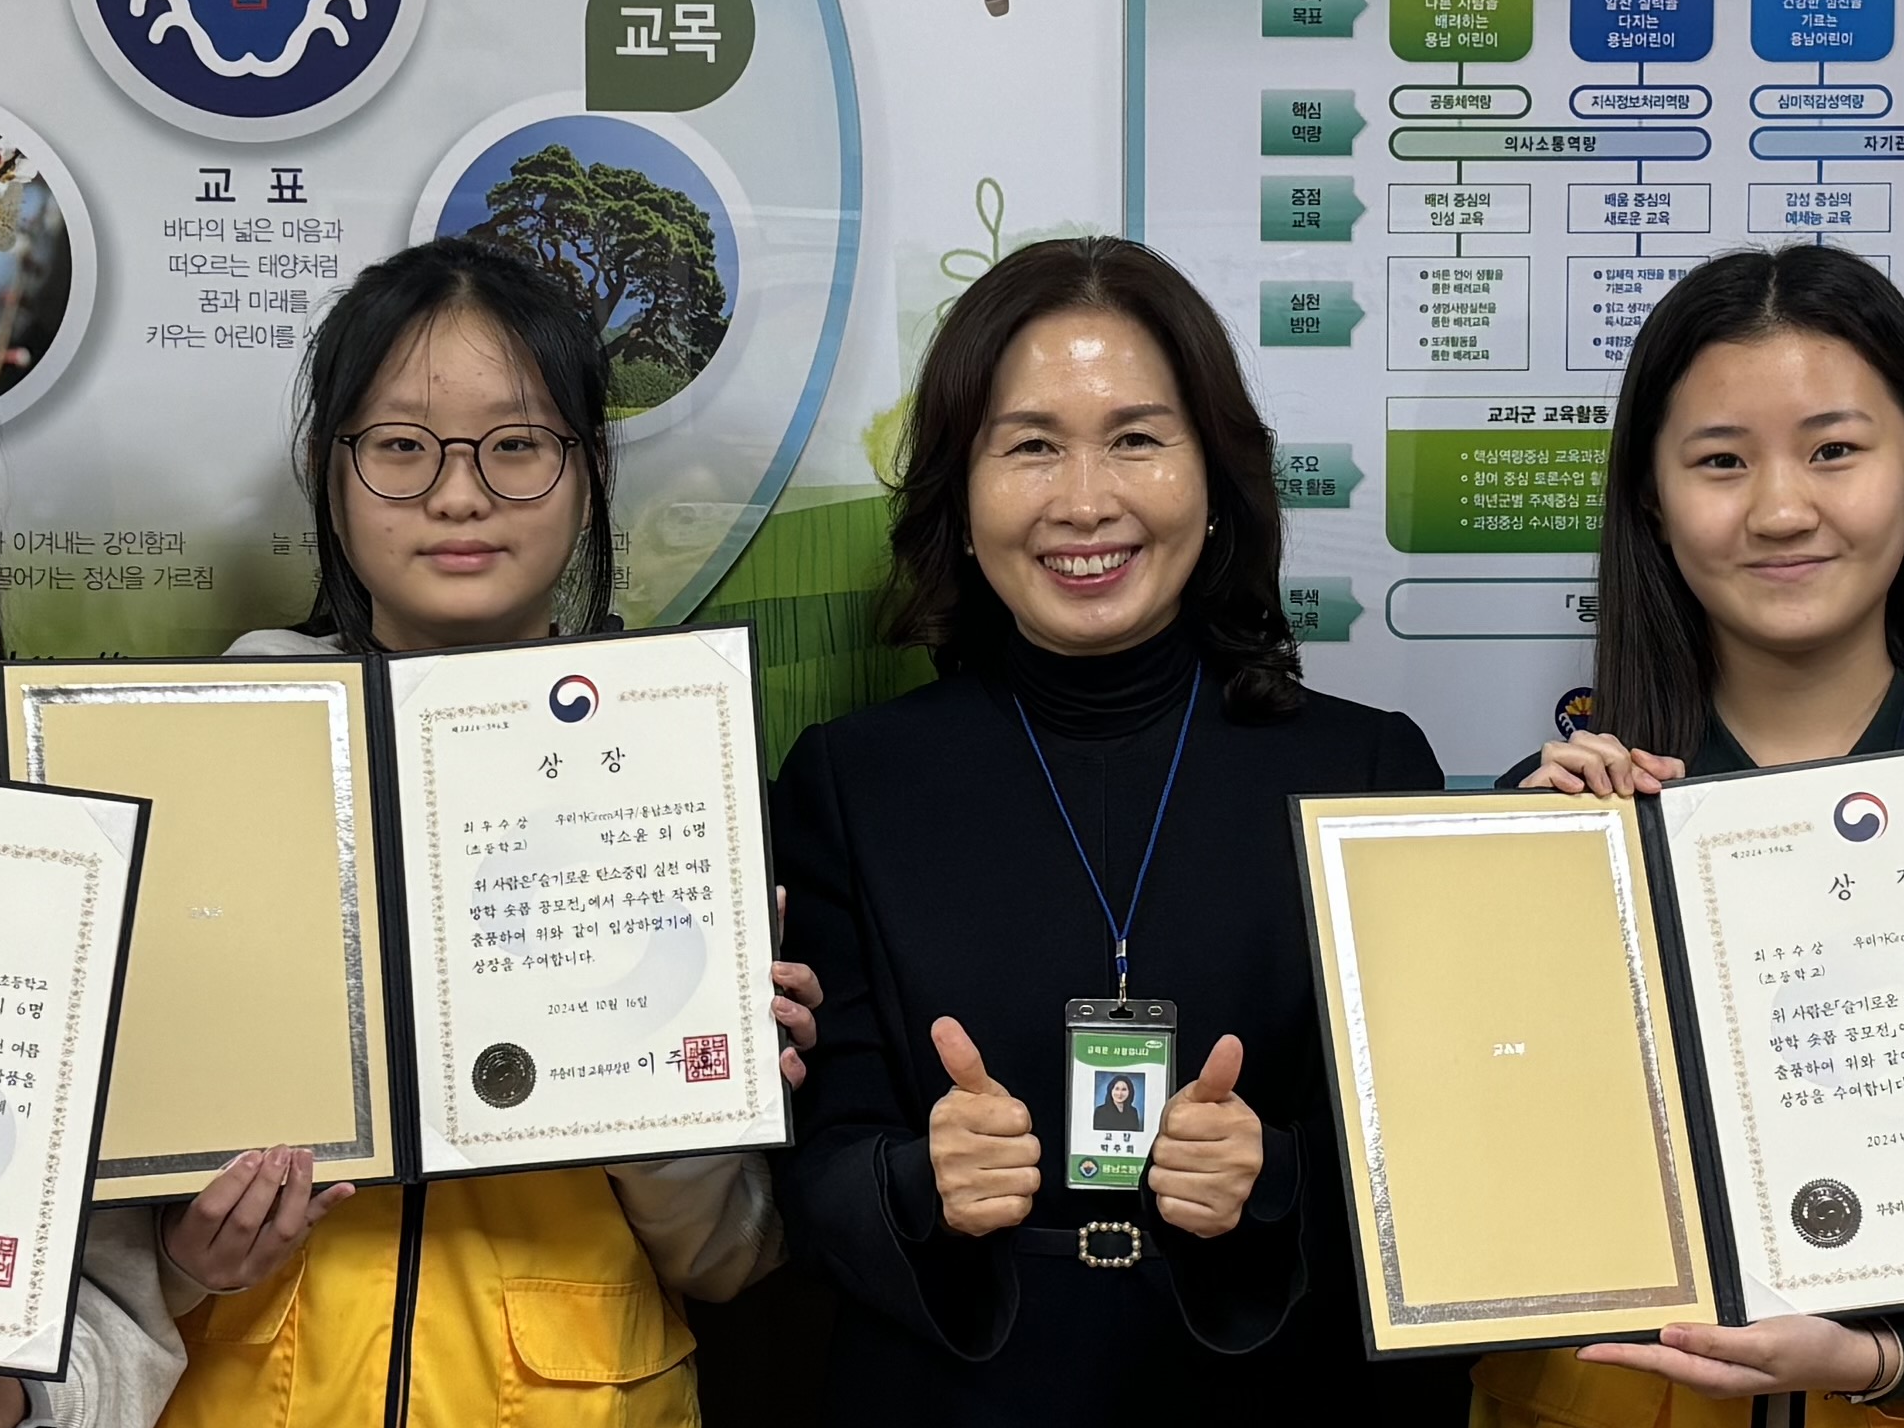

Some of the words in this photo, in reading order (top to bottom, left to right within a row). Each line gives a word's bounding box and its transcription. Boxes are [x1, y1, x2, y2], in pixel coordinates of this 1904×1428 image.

[616, 4, 721, 63] 교목
[1430, 95, 1491, 109] 공동체역량
[1592, 95, 1689, 109] 지식정보처리역량
[1778, 94, 1864, 109] 심미적감성역량
[1504, 136, 1597, 152] 의사소통역량
[164, 218, 224, 242] 바다의
[234, 218, 274, 242] 넓은
[283, 218, 344, 244] 마음과
[169, 253, 250, 277] 떠오르는
[259, 254, 337, 279] 태양처럼
[198, 289, 241, 313] 꿈과
[249, 289, 310, 314] 미래를
[147, 324, 207, 348] 키우는
[215, 324, 296, 348] 어린이를
[14, 531, 96, 555] 이겨내는
[103, 531, 186, 555] 강인함과
[81, 566, 146, 594] 정신을
[153, 563, 216, 594] 가르침
